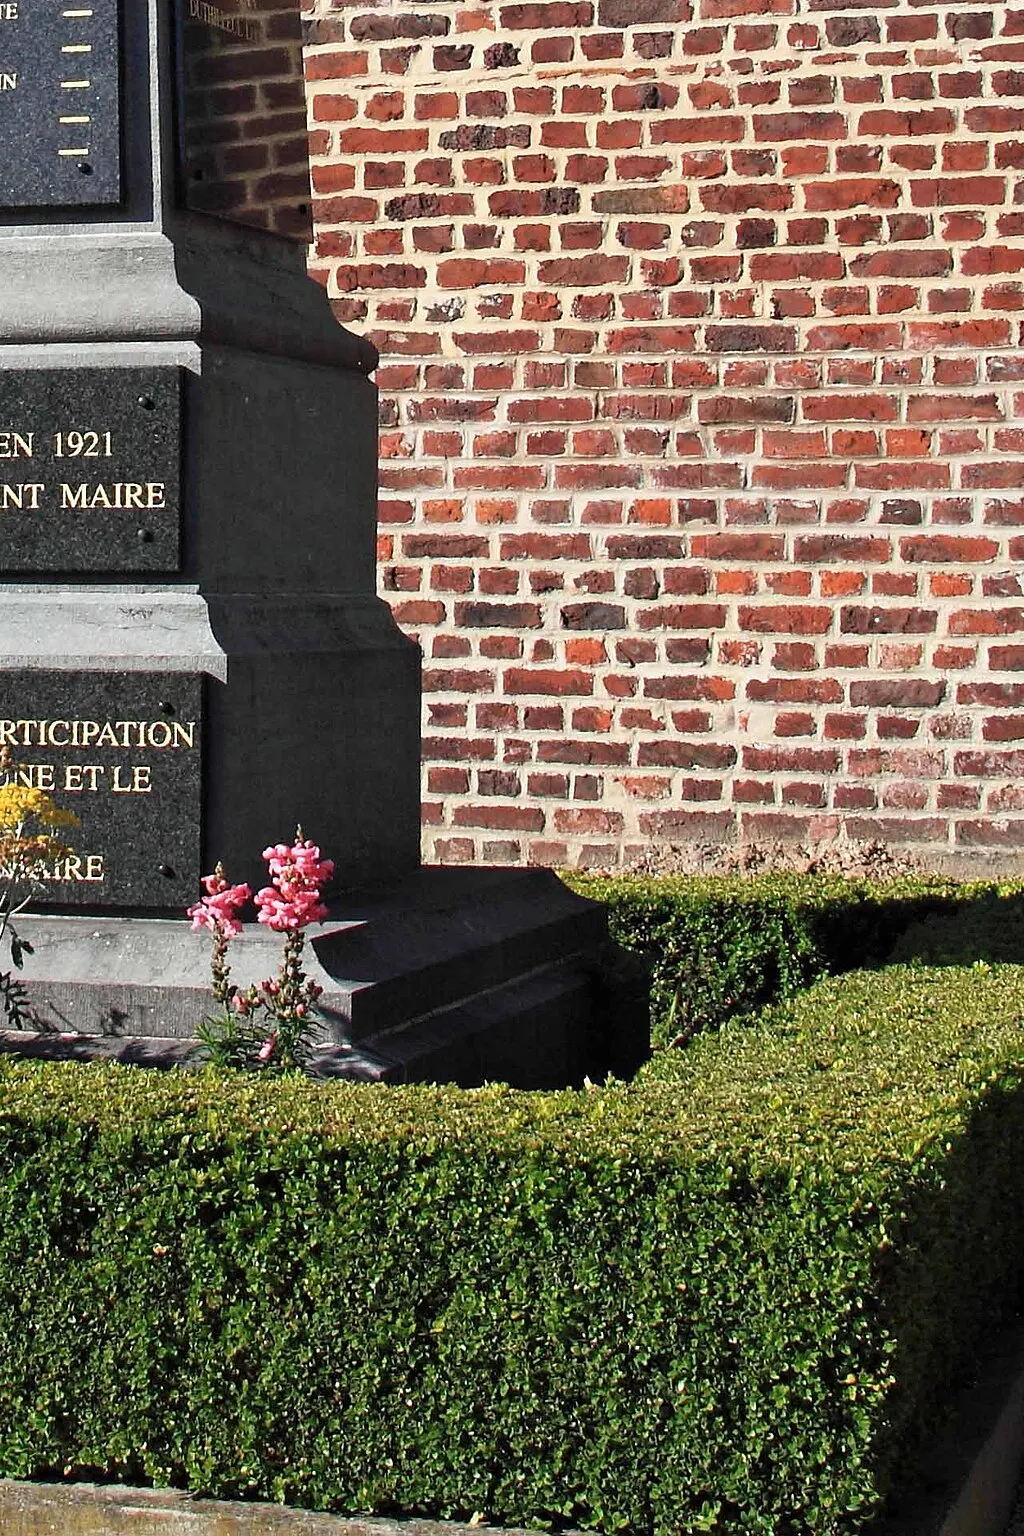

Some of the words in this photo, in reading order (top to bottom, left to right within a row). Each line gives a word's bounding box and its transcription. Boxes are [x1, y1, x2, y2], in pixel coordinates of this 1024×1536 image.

[54, 431, 113, 458] 1921
[59, 482, 166, 509] MAIRE
[64, 765, 105, 791] ET
[112, 766, 153, 793] LE
